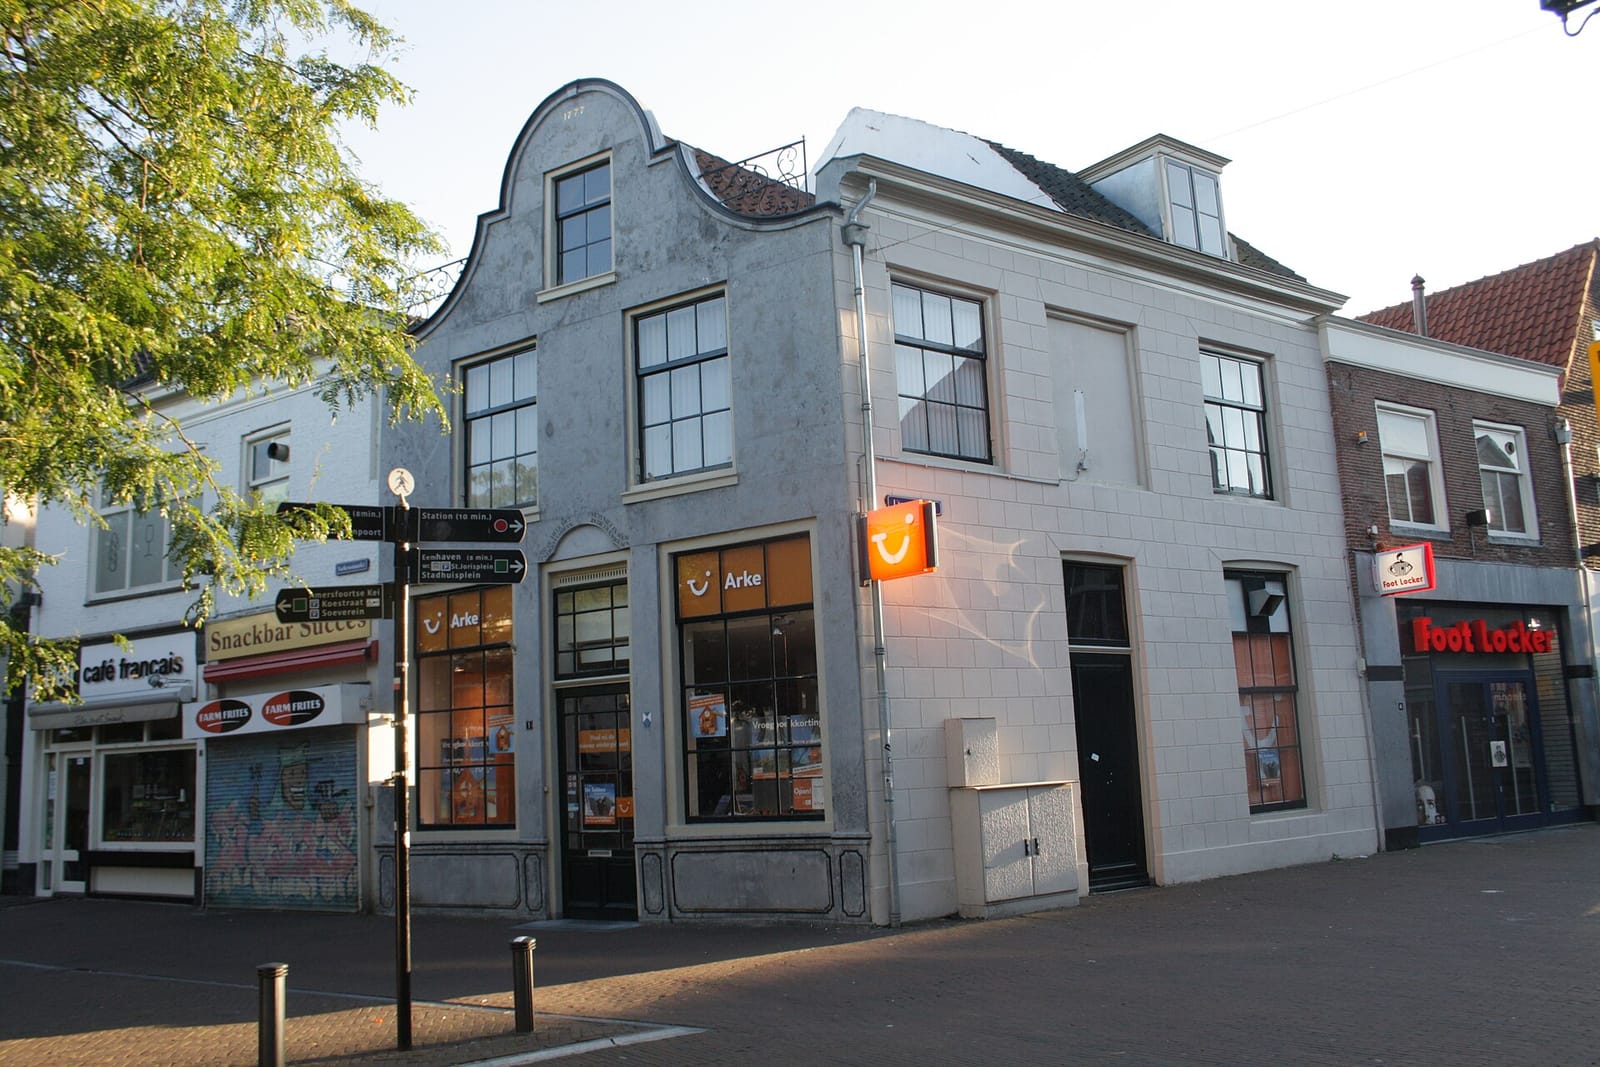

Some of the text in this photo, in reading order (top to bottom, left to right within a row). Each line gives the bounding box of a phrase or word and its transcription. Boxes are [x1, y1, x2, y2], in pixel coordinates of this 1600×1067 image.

[421, 512, 453, 520] Station
[470, 512, 492, 520] min.)
[421, 553, 461, 561] Eemhaven
[421, 571, 481, 580] Stadhuisplein
[724, 570, 762, 590] Arke
[1399, 576, 1424, 586] Locker
[312, 588, 380, 599] mersfoortse Kei
[321, 599, 364, 608] Koestraat
[321, 607, 365, 617] Soeverein
[450, 611, 479, 629] Arke
[210, 619, 366, 652] Snackbar Succes
[1413, 616, 1555, 653] Foot Locker
[83, 658, 115, 683] café
[266, 700, 321, 715] FARM FRITES
[199, 709, 249, 722] FARM FRITES
